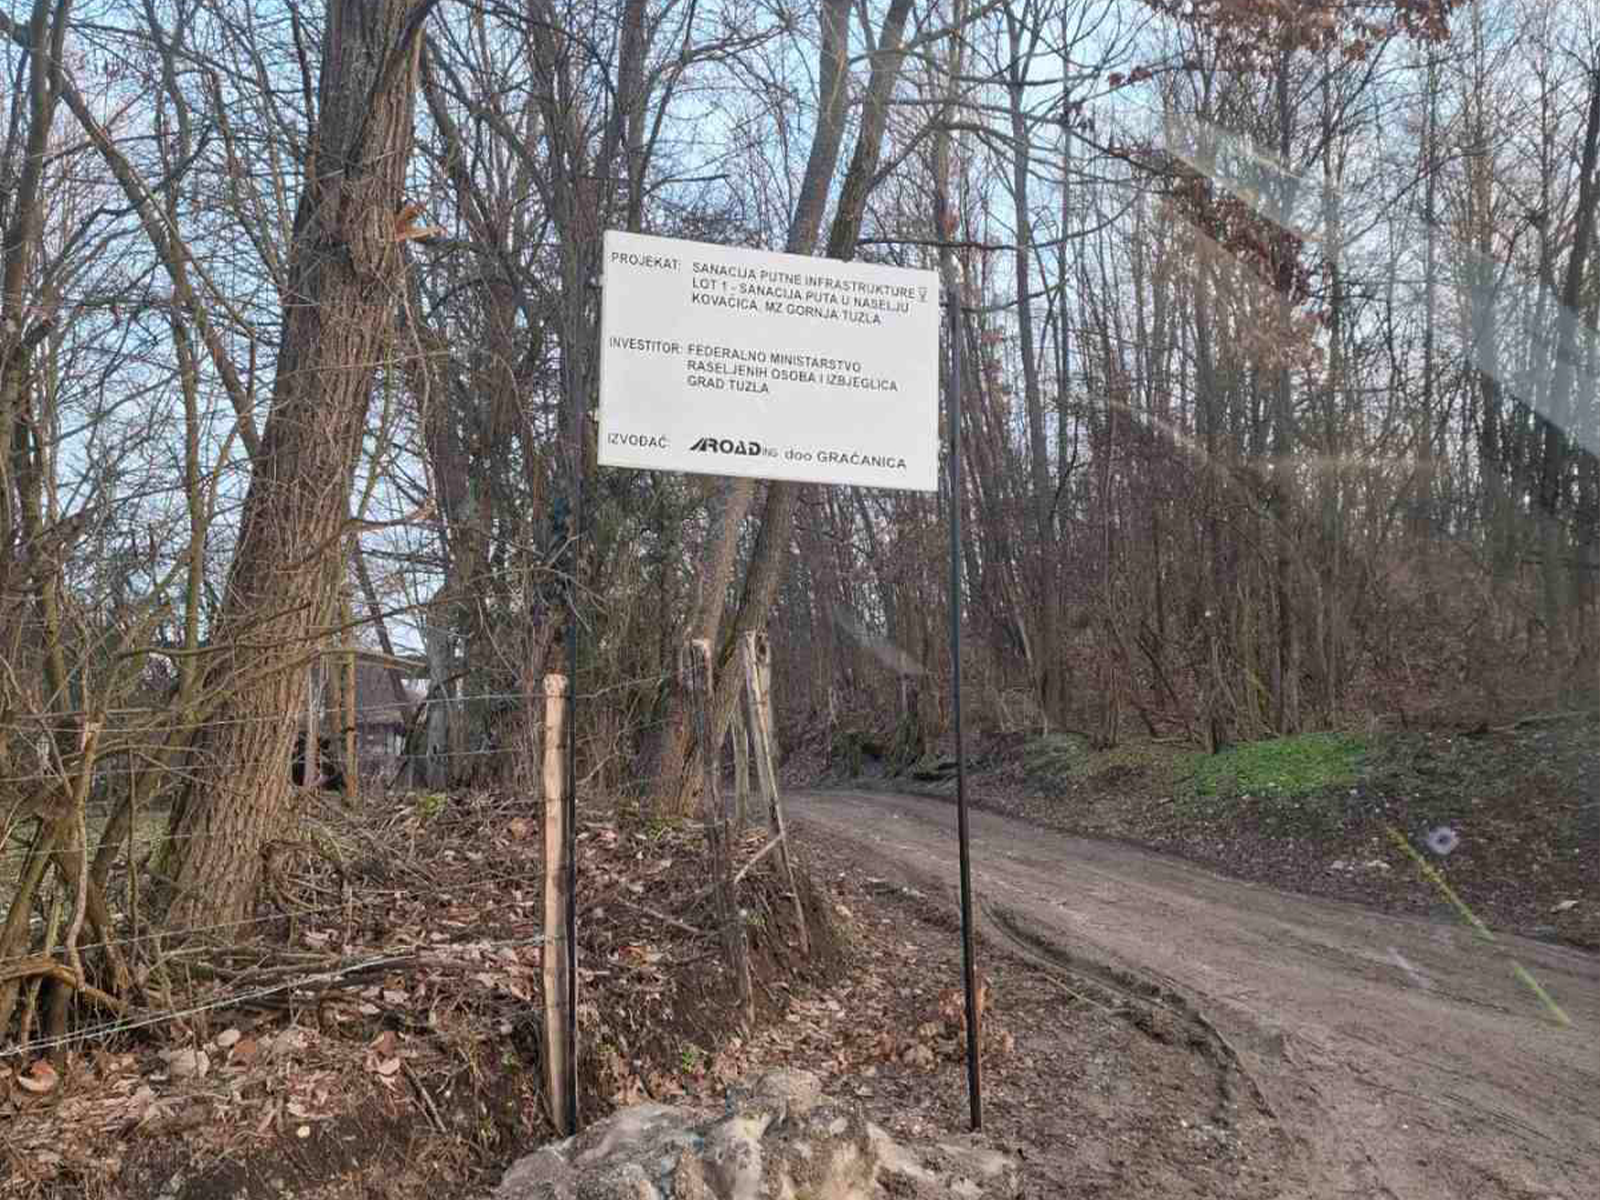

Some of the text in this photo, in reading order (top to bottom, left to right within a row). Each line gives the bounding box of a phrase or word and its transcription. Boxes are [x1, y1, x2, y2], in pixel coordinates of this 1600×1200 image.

[692, 277, 717, 290] LOT
[740, 283, 801, 301] SANACIJA
[805, 290, 838, 304] PUTA
[842, 295, 850, 306] U
[854, 297, 909, 313] NASELJU
[693, 262, 756, 280] SANACIJA
[760, 270, 801, 285] PUTNE
[805, 274, 915, 299] INFRASTRUKTURE
[766, 300, 783, 313] MZ
[787, 303, 839, 320] GORNJA
[842, 310, 882, 325] TUZLA
[688, 343, 766, 363] FEDERALNO
[770, 352, 862, 373] MINISTARSTVO
[687, 359, 768, 378] RASELJENIH
[771, 367, 816, 383] OSOBA
[827, 374, 898, 392] IZBJEGLICA
[687, 375, 769, 394] GRAD TUZLA
[785, 449, 813, 462] doo
